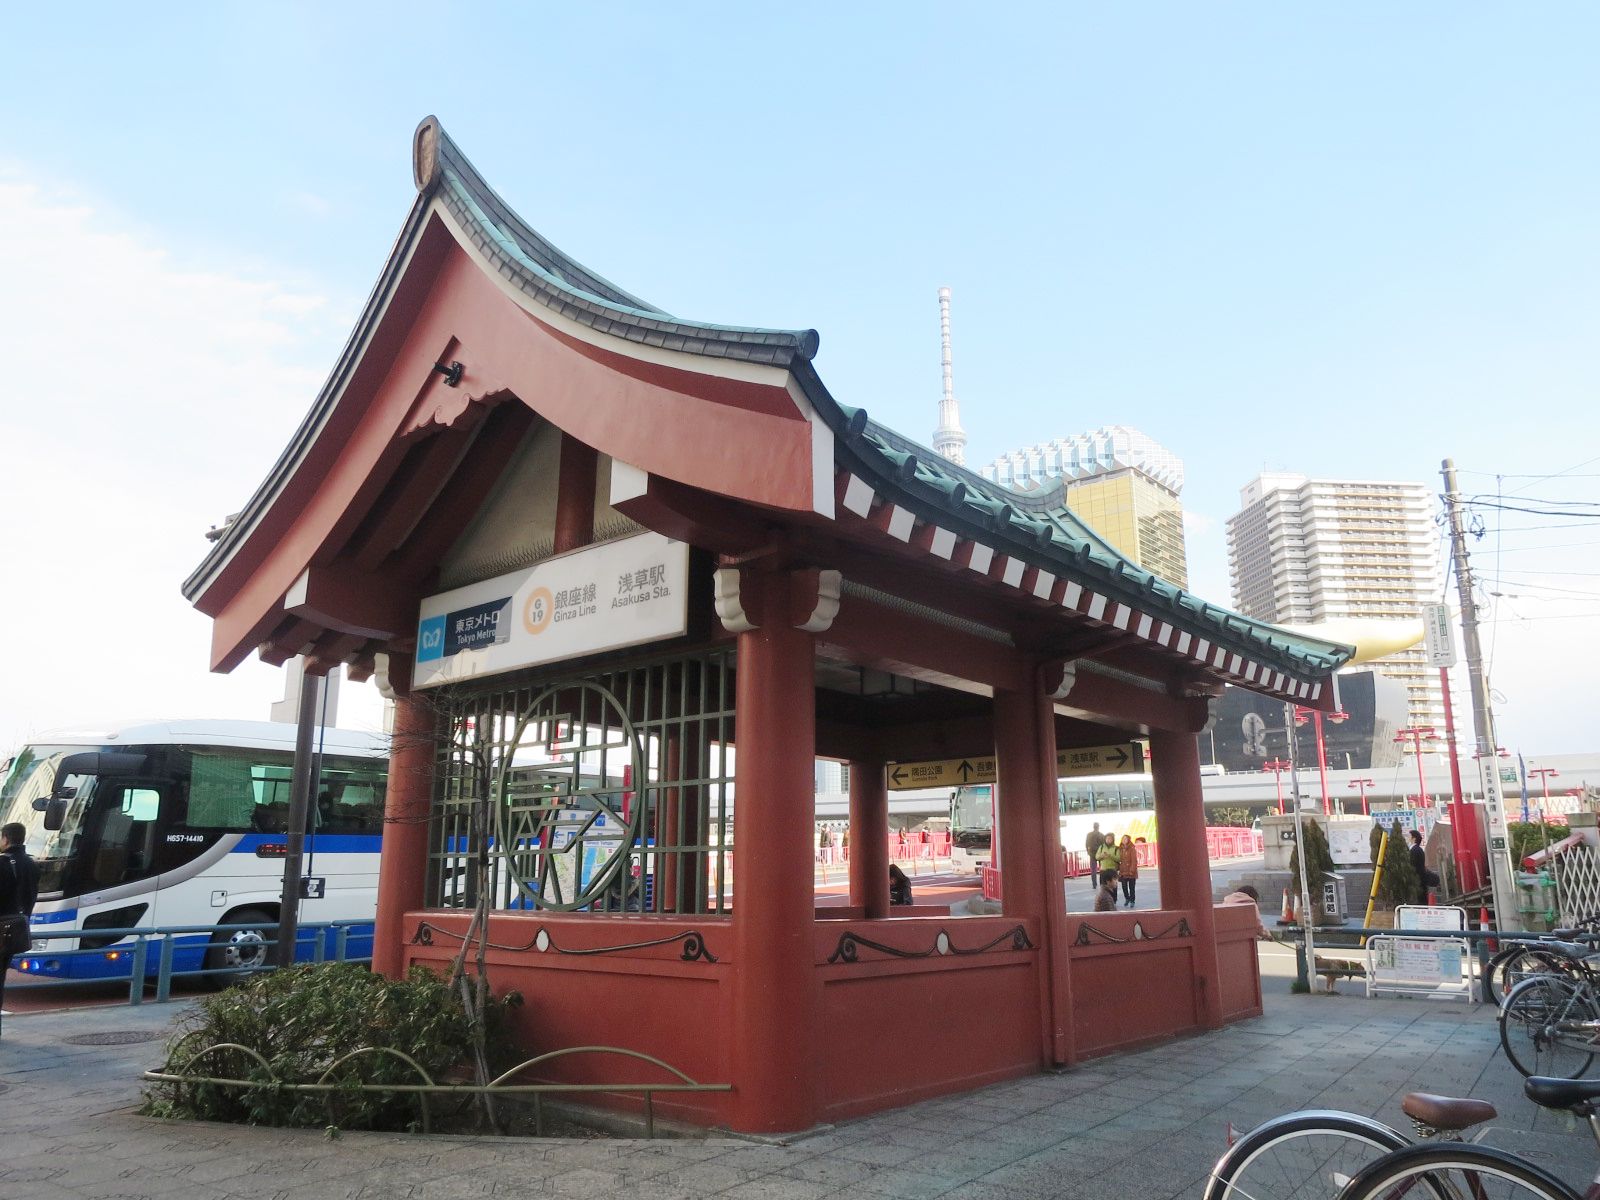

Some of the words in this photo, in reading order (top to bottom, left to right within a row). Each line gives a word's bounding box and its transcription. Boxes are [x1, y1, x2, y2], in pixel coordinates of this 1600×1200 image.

[618, 564, 665, 594] 浅草駅
[534, 598, 542, 609] G
[554, 583, 597, 610] 銀座線
[611, 592, 650, 609] Asakusa
[652, 586, 671, 599] Sta.
[455, 609, 500, 633] 東京メトロ
[532, 610, 544, 623] 19
[553, 610, 577, 623] Ginza
[578, 605, 597, 617] Line
[457, 633, 476, 645] Tokyo
[476, 629, 497, 640] Metro
[1071, 751, 1099, 763] 浅草駅
[911, 765, 943, 776] 隅田公園
[976, 761, 996, 772] 吾妻
